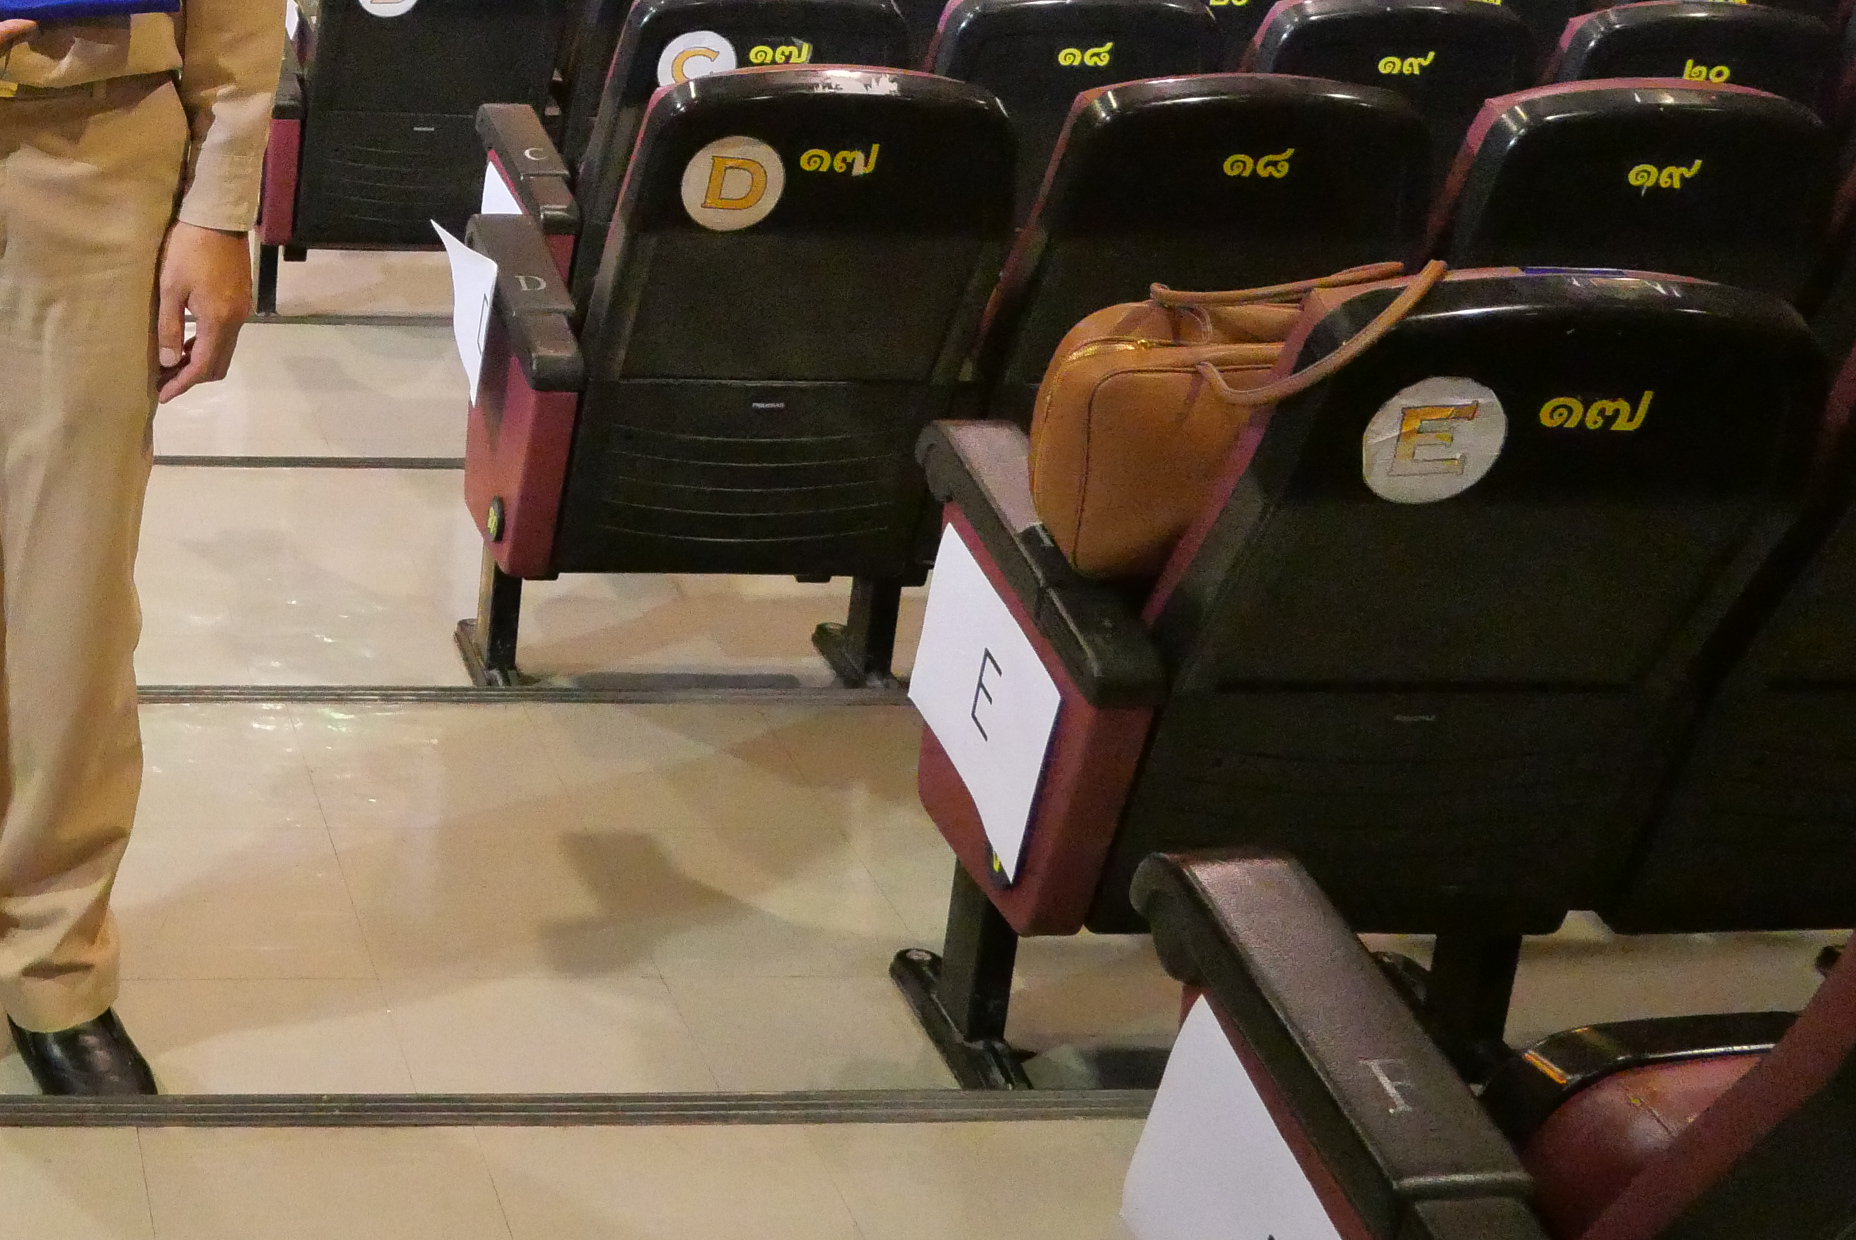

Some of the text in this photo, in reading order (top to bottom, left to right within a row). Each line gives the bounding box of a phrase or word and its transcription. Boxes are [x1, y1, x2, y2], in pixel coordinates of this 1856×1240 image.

[671, 46, 721, 85] C
[749, 41, 812, 64] ๑๗
[1057, 41, 1114, 68] ๑๘
[1377, 50, 1436, 76] ๑๙
[1683, 60, 1731, 84] ๒๐
[523, 147, 548, 161] C
[799, 143, 881, 177] ๑๗
[1222, 147, 1296, 180] ๑๘
[700, 155, 768, 211] D
[1627, 159, 1703, 189] ๑๙
[514, 274, 547, 292] D
[1539, 390, 1654, 432] ๑๗
[1387, 400, 1479, 478] E
[971, 647, 1002, 742] E
[1359, 1058, 1415, 1115] F
